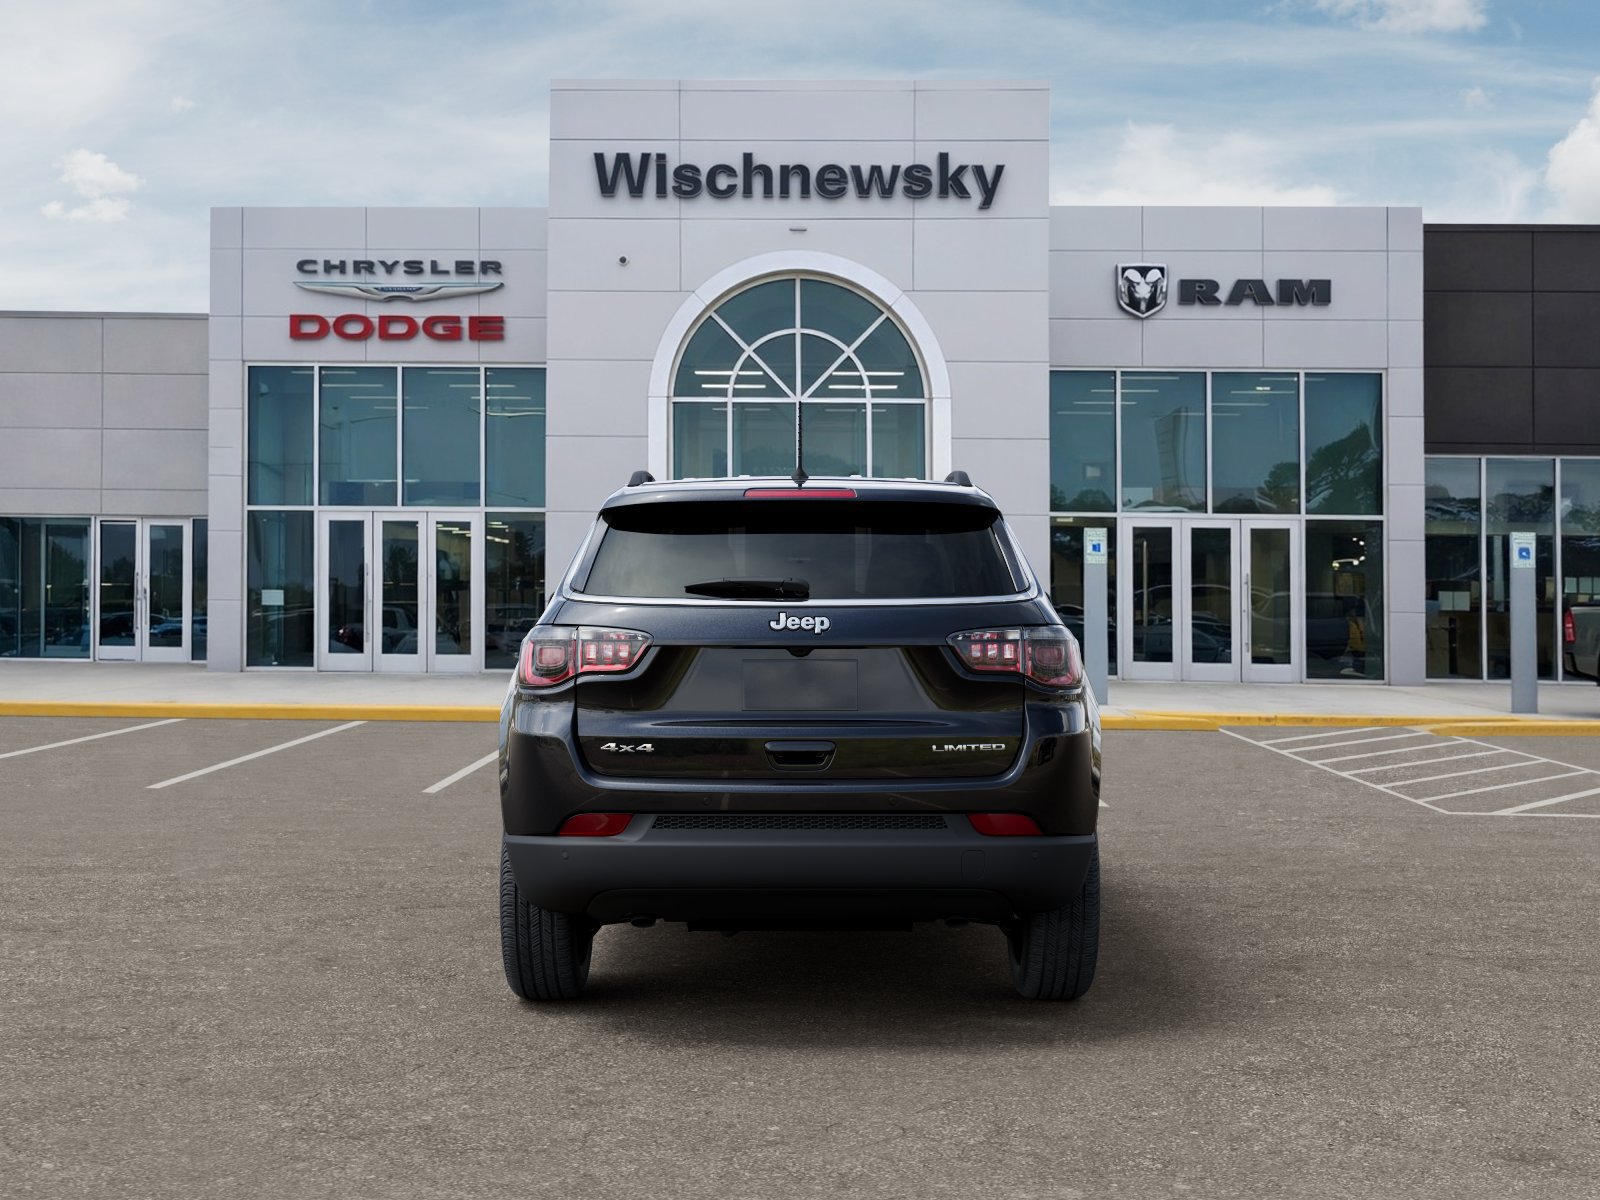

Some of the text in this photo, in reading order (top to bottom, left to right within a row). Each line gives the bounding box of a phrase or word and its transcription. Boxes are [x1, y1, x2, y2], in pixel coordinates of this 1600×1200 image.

[593, 152, 1005, 210] Wischnewsky
[296, 259, 503, 276] CHRYSLER
[1177, 279, 1332, 306] RAM
[289, 314, 505, 341] DODGE
[769, 612, 831, 634] Jeep
[600, 742, 655, 753] 4x4
[931, 743, 1006, 752] LIMITED
